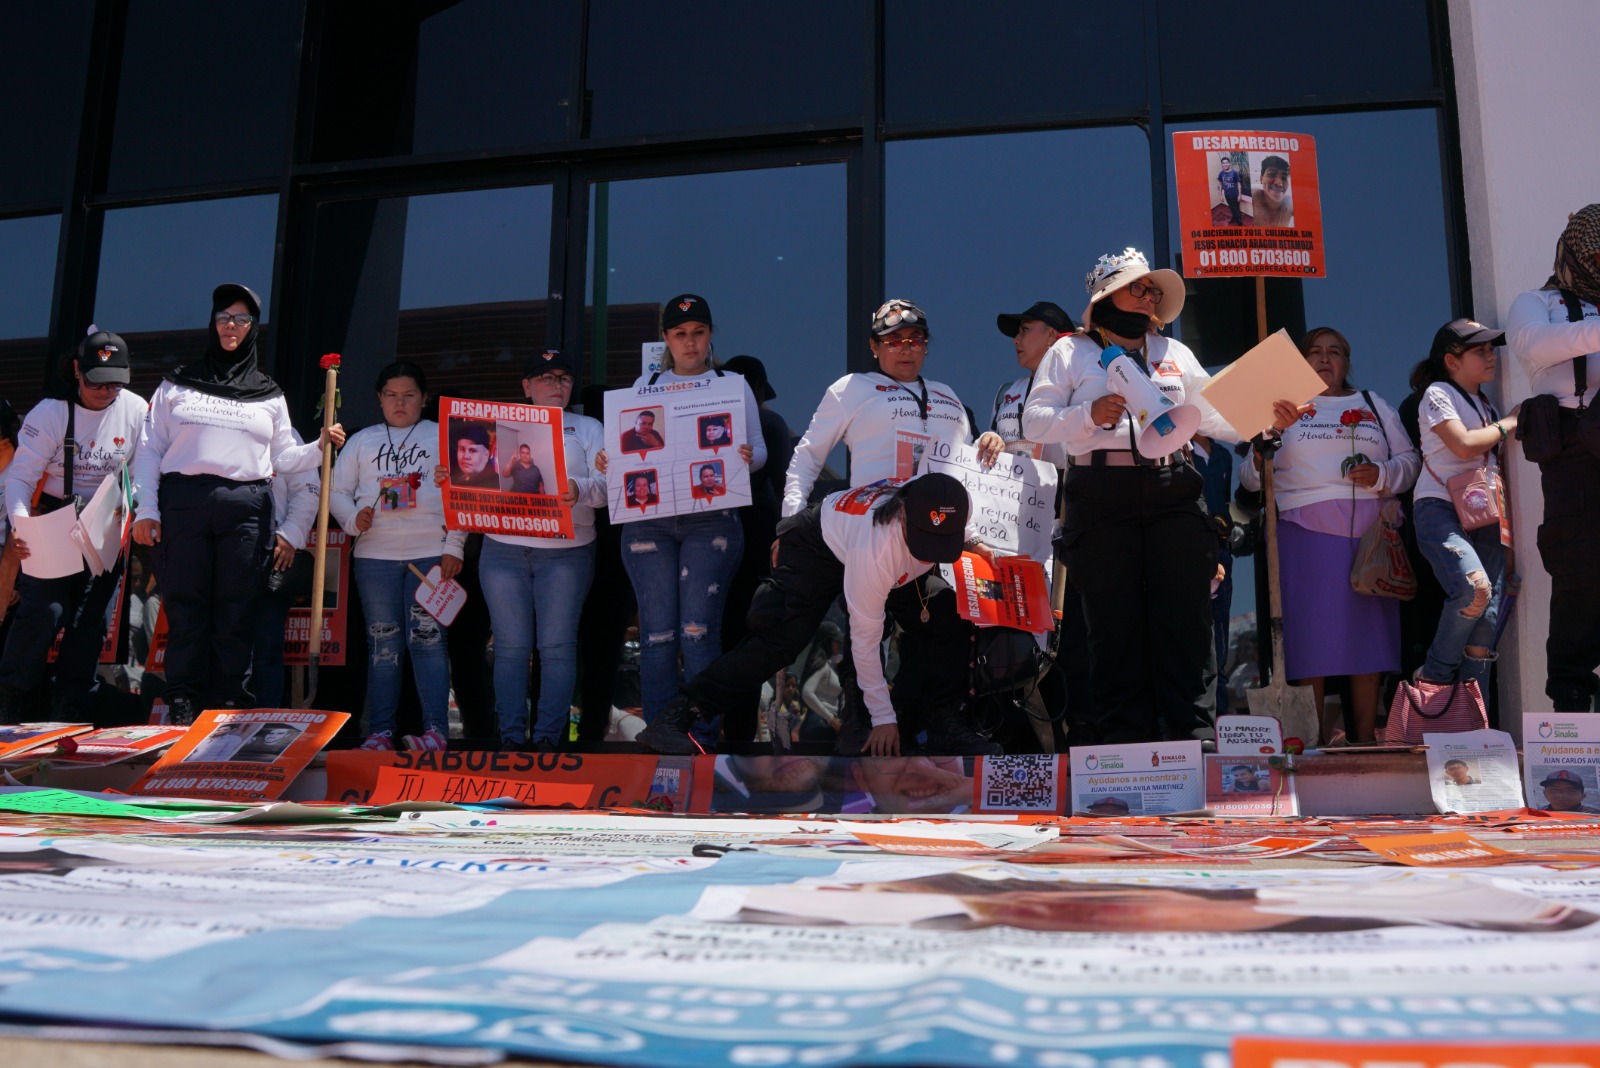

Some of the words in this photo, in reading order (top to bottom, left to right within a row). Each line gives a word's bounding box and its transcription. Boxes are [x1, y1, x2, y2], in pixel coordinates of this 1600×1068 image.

[1192, 136, 1299, 151] DESAPARECIDO
[1202, 229, 1242, 238] DICIEMBRE
[1194, 239, 1216, 250] JESUS
[1217, 239, 1248, 250] IGNACIO
[1249, 239, 1277, 250] ARAGON
[1200, 250, 1216, 266] 01
[1219, 250, 1248, 266] 800
[1250, 250, 1310, 266] 6703600
[1203, 265, 1244, 273] SABUESOS
[450, 400, 550, 424] DESAPARECIDO
[1298, 431, 1334, 441] Hasta
[371, 443, 431, 471] Hasta
[930, 441, 951, 459] 10
[955, 447, 971, 464] de
[989, 460, 1024, 481] ayo
[450, 491, 459, 499] 23
[460, 492, 476, 501] ABRIL
[479, 493, 495, 502] 2021
[531, 498, 559, 508] SINALOA
[1027, 489, 1046, 509] de
[450, 502, 478, 512] RAFAEL
[480, 504, 526, 515] HERNANDEZ
[528, 508, 563, 518] NIEBLAS
[457, 512, 473, 526] 01
[474, 514, 500, 529] 800
[502, 516, 560, 533] 6703600
[981, 505, 1020, 525] reyna
[1026, 516, 1041, 533] de
[961, 556, 981, 618] DESAPARECIDO
[213, 713, 328, 724] DESAPARECIDO
[1554, 730, 1579, 738] Sinaloa
[393, 750, 583, 772] SABUESOS
[1100, 761, 1124, 770] Sinaloa
[144, 778, 165, 789] 01
[164, 778, 198, 789] 800
[196, 778, 269, 791] 6703600
[397, 774, 424, 801] TU
[440, 776, 536, 802] FAMILIA
[1088, 776, 1130, 786] Ayúdanos
[1139, 774, 1181, 782] encontrar
